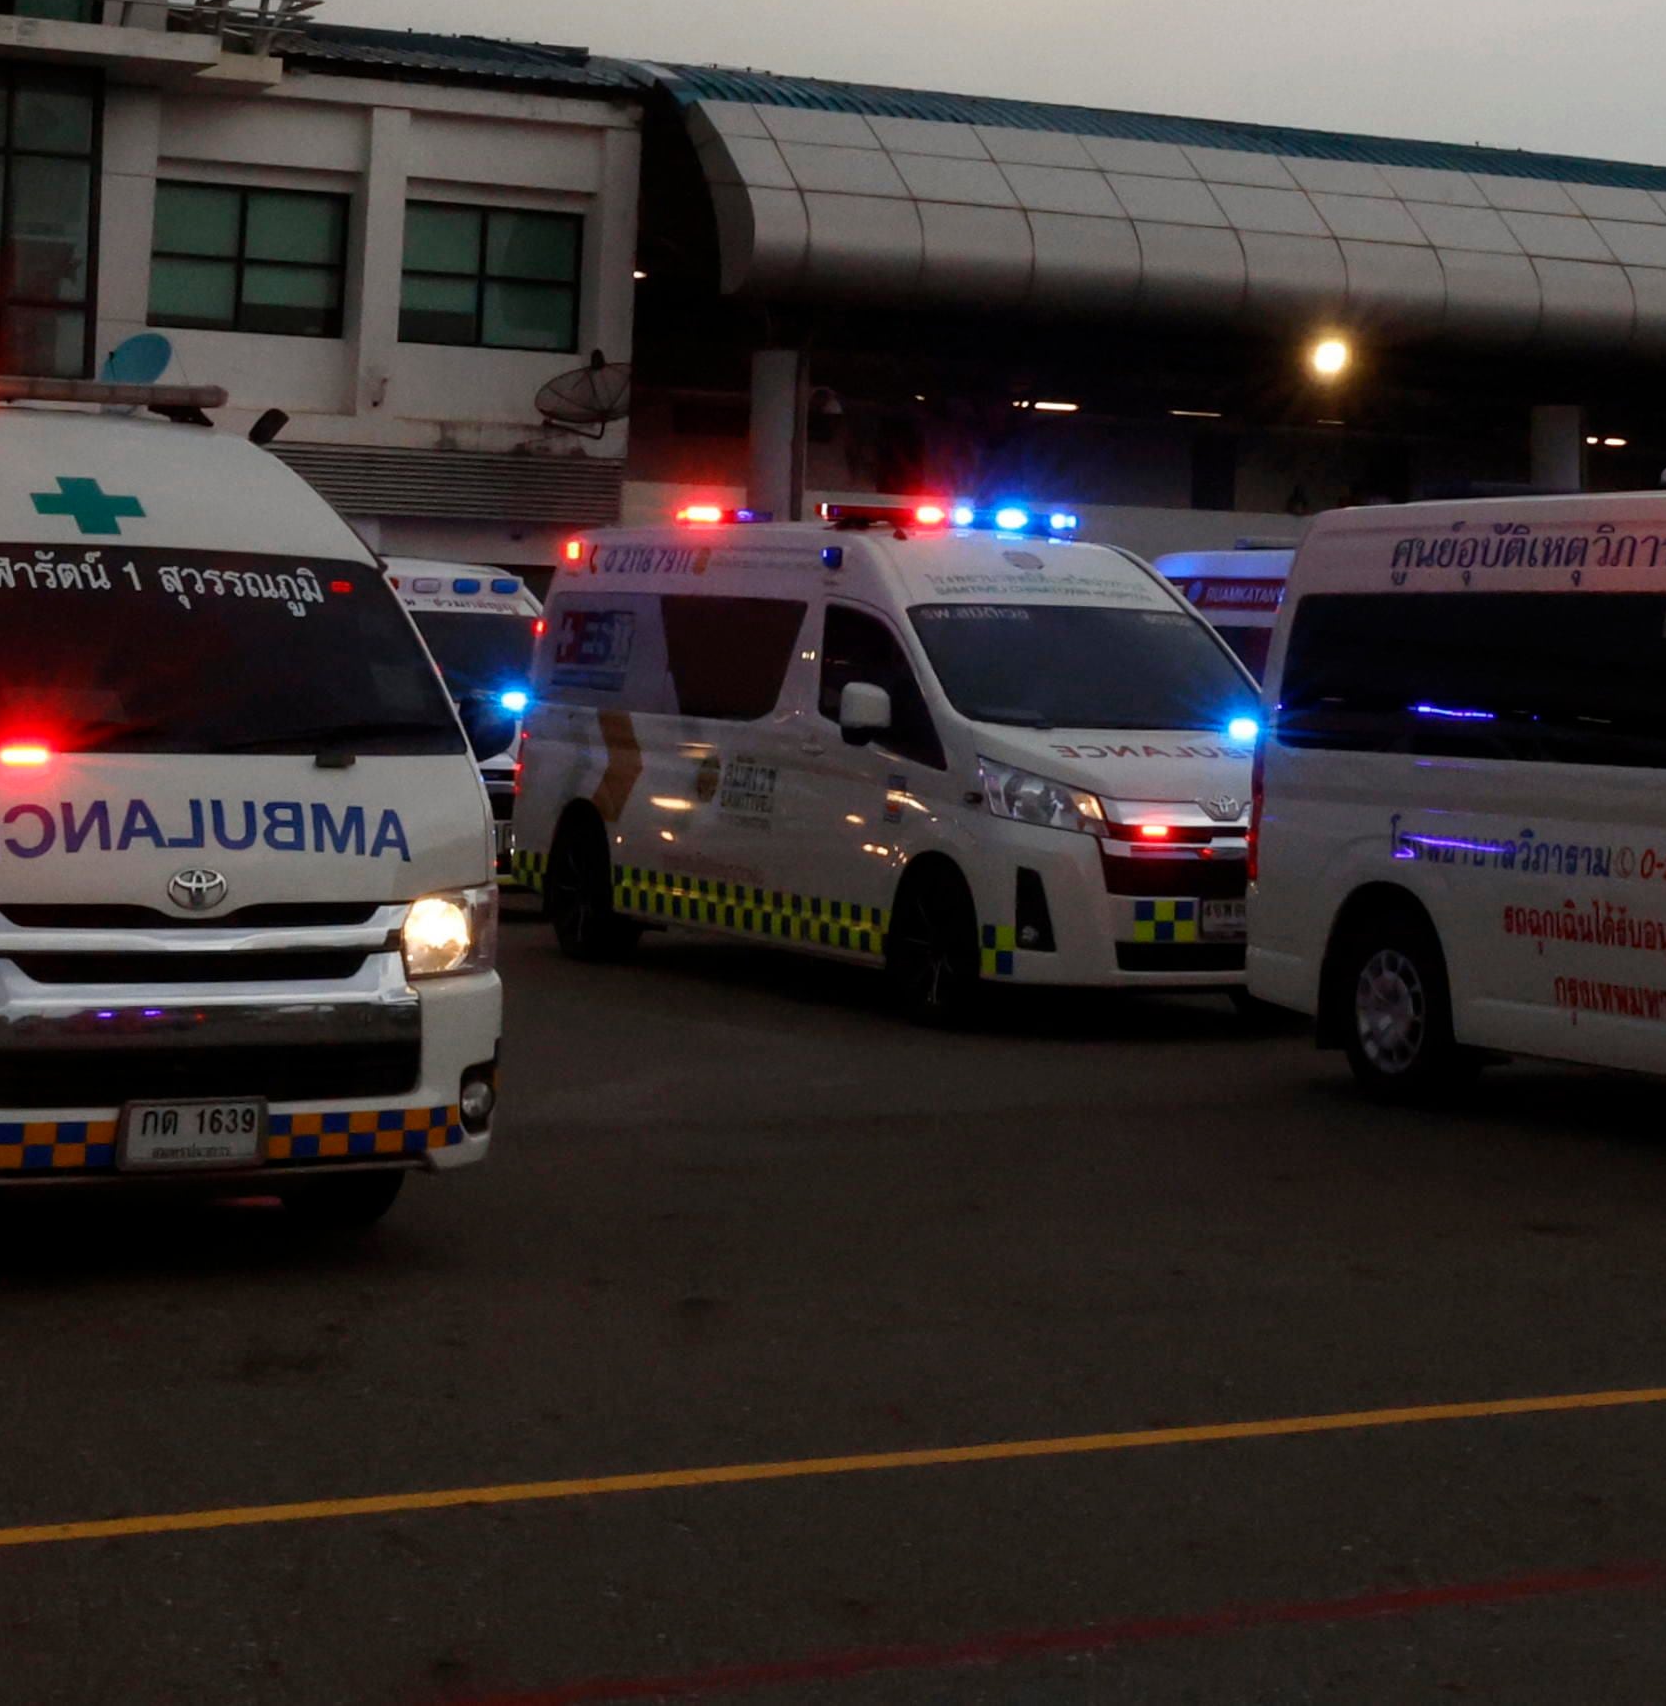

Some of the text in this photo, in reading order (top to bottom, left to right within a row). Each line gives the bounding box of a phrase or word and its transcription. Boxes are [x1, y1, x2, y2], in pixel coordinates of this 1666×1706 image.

[123, 561, 142, 592] 1
[158, 564, 325, 618] สุวรรณภูมิ
[141, 1108, 256, 1136] กด 1639
